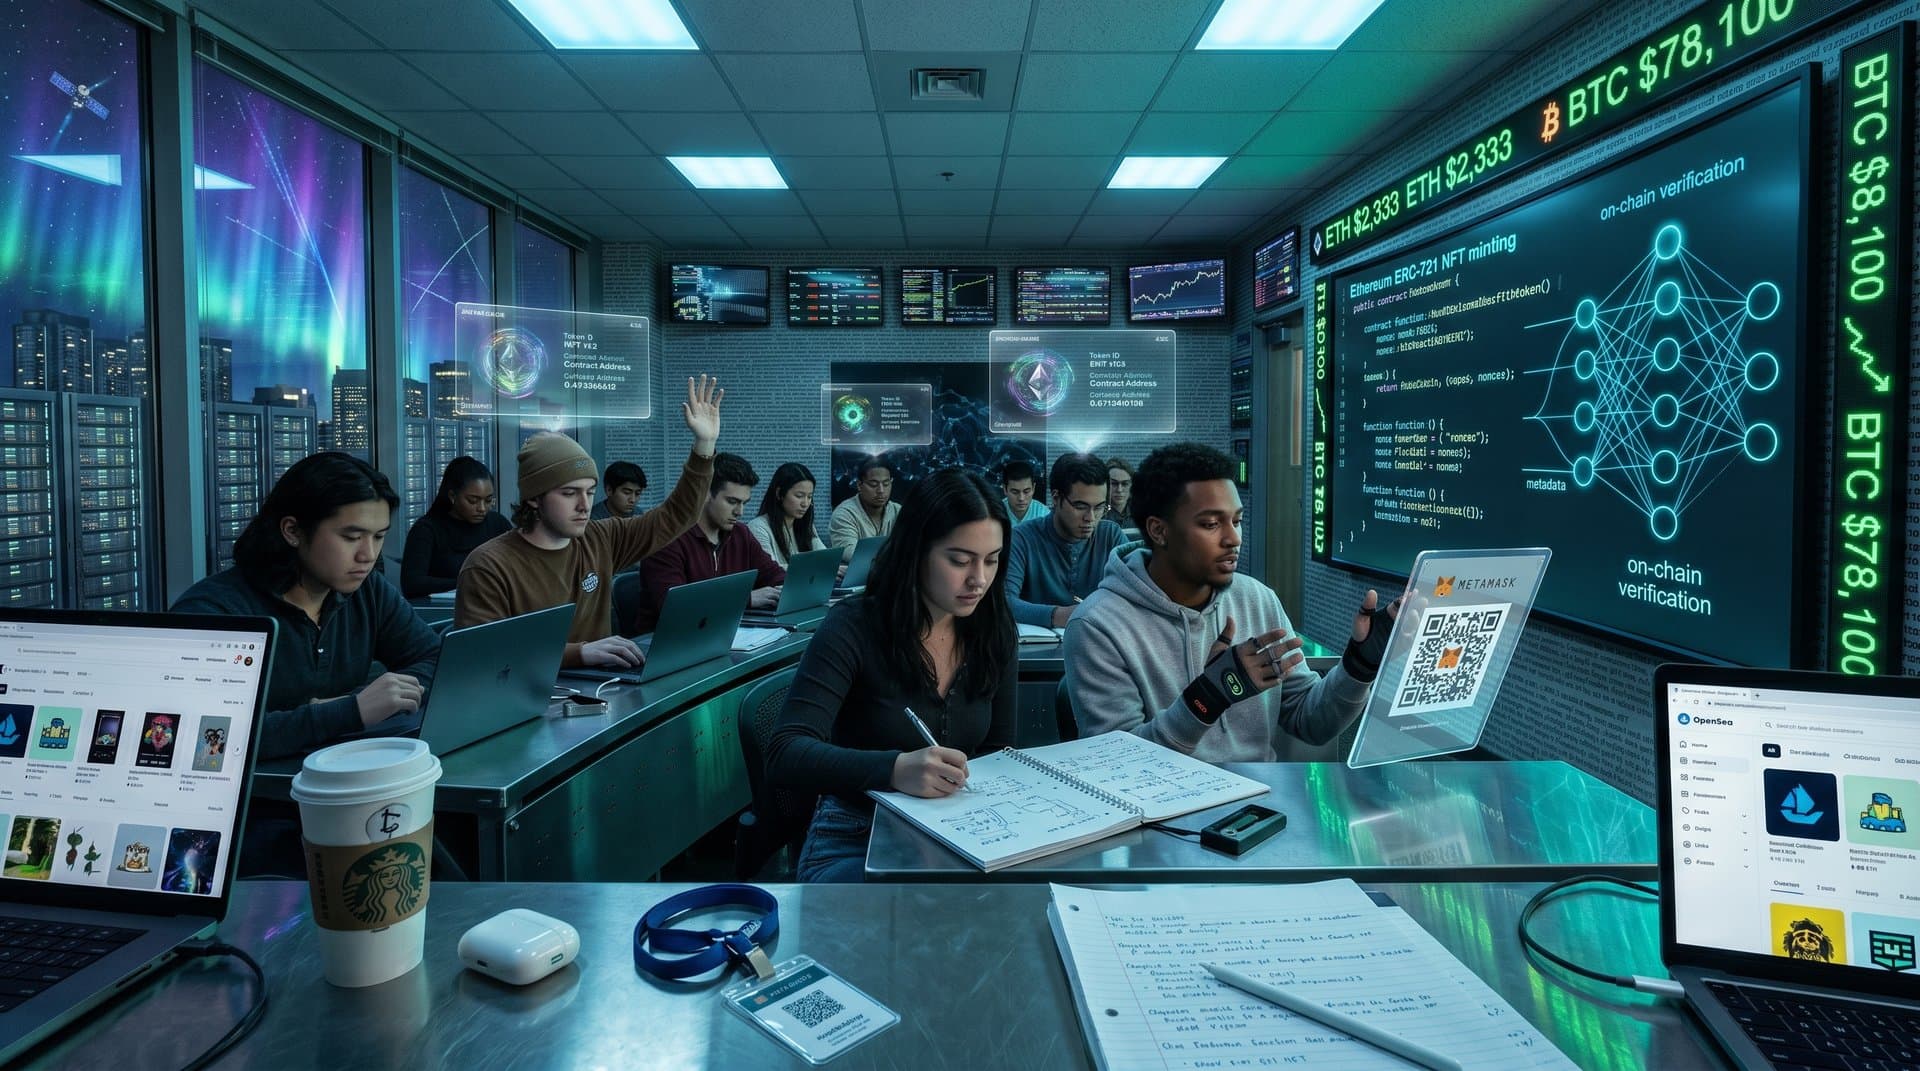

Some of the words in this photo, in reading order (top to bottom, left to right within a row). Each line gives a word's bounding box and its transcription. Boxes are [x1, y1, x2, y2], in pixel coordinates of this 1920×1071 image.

[1568, 65, 1629, 128] BTC
[1853, 53, 1889, 146] BTC
[1325, 215, 1350, 249] ETH
[1353, 191, 1399, 237] $2,333
[1406, 165, 1441, 209] ETH
[1446, 129, 1512, 190] $2,333
[1600, 188, 1656, 221] on-chain
[1660, 156, 1745, 199] verification
[1846, 155, 1890, 301] $8,100
[1350, 274, 1393, 299] Ethereum
[1394, 259, 1438, 285] ERC-721
[1442, 249, 1466, 271] NFT
[1468, 233, 1517, 262] minting
[563, 333, 585, 342] Token
[563, 360, 599, 370] Contract
[599, 362, 631, 371] Address
[1846, 413, 1881, 499] BTC
[1526, 478, 1567, 491] metadata
[1457, 577, 1518, 591] METAMASK
[1627, 559, 1702, 586] on-chain
[1618, 581, 1711, 616] verification
[1693, 716, 1733, 726] OpenSea
